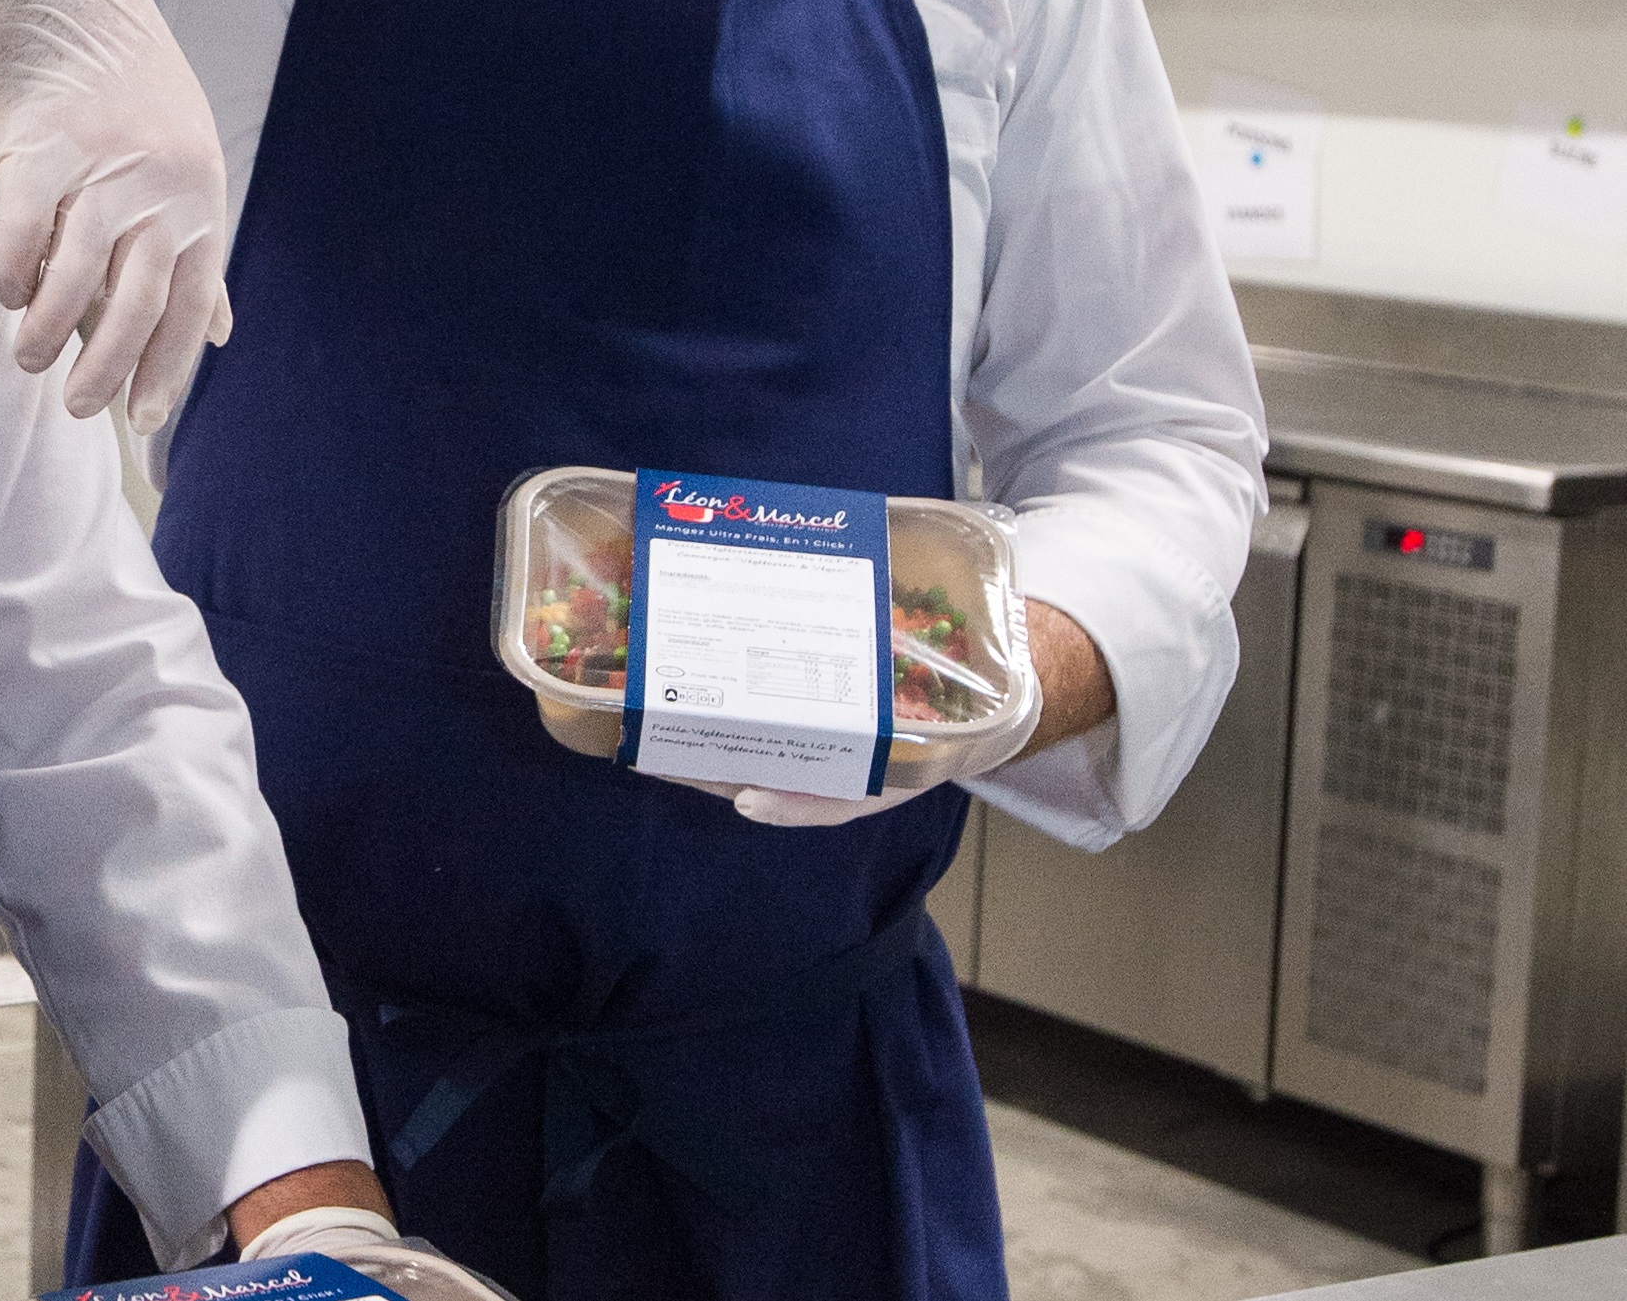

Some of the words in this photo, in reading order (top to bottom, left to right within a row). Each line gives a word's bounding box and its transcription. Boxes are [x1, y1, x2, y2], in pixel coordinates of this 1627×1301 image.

[663, 487, 729, 508] Léon
[747, 505, 849, 529] Marcel
[655, 523, 705, 535] Mangez
[709, 530, 741, 538] Ultra
[784, 537, 800, 545] En
[813, 539, 845, 549] Click
[201, 1269, 313, 1300] Marcel
